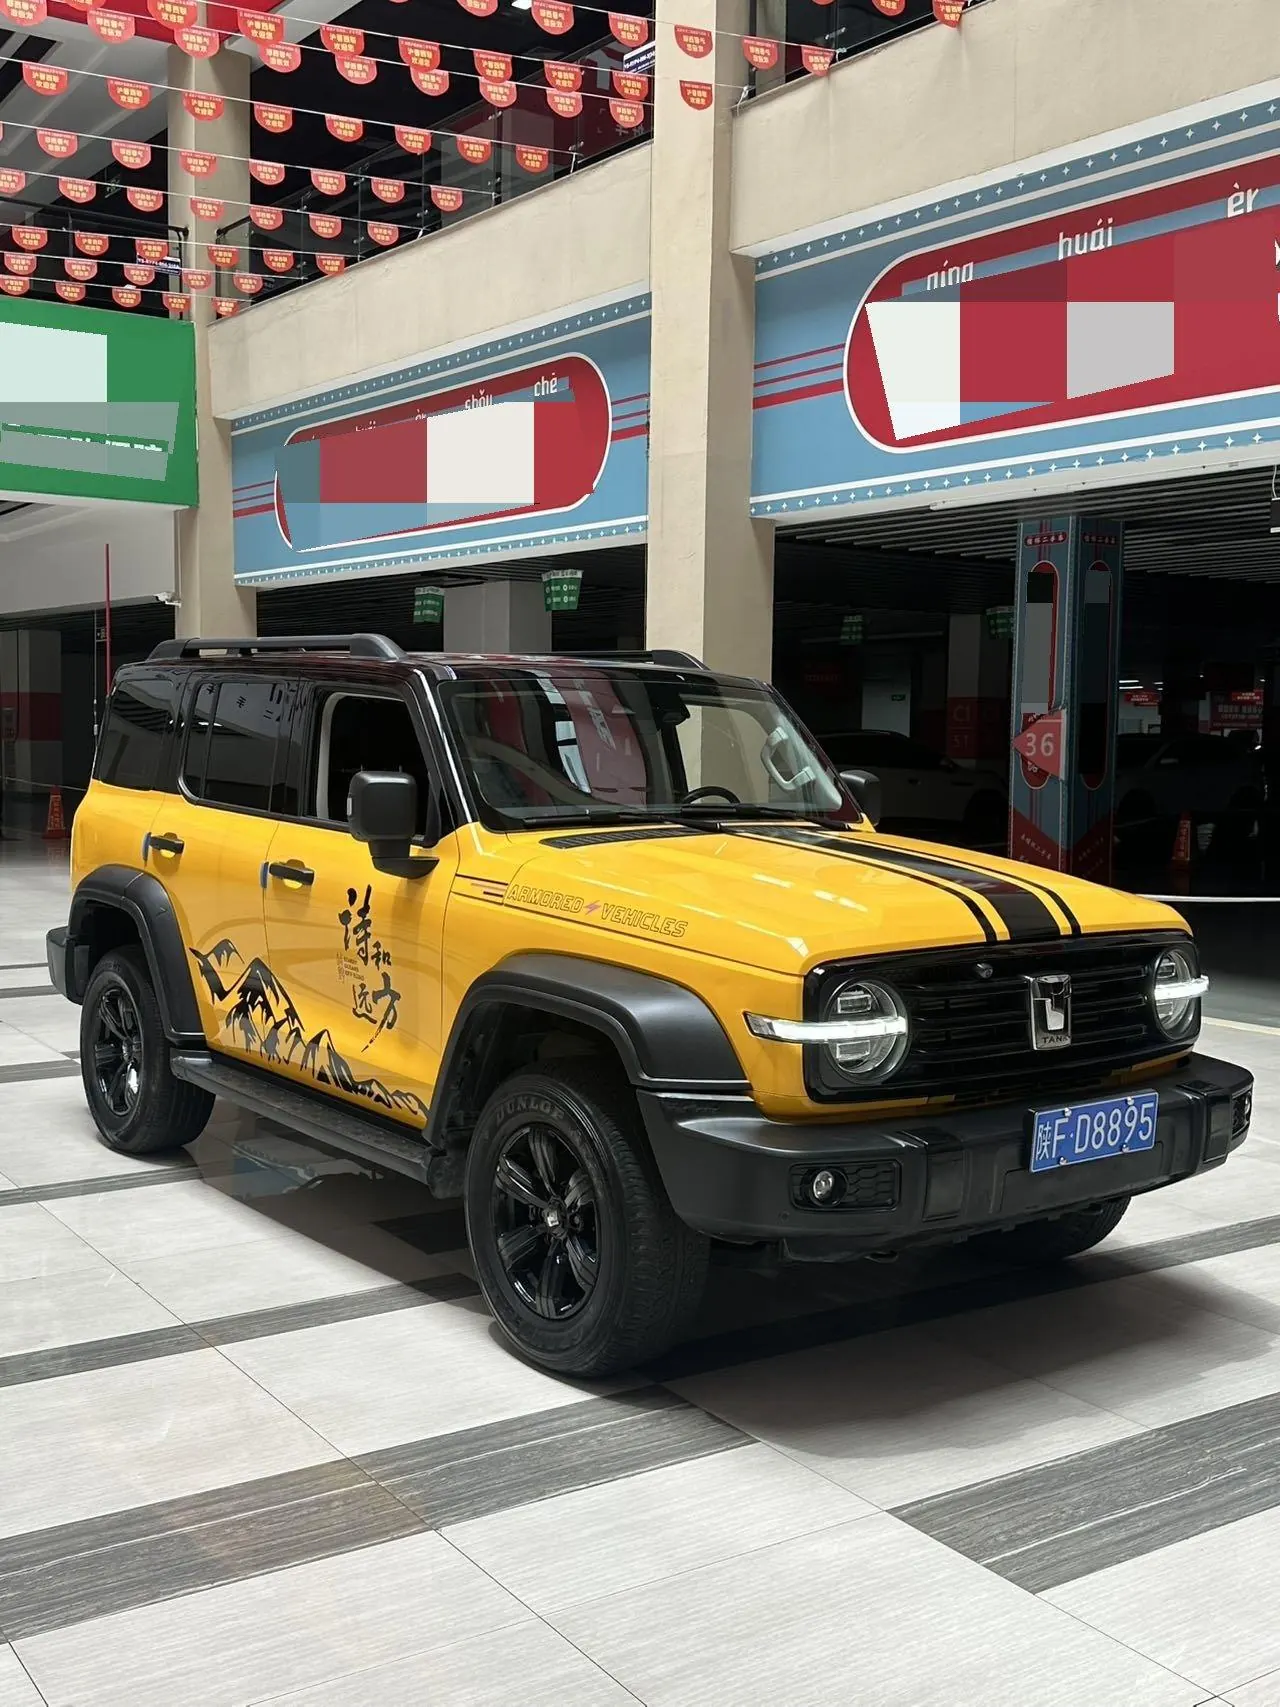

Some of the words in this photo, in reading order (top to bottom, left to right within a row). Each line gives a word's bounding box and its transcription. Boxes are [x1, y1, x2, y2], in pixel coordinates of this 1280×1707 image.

[1057, 217, 1114, 261] huái
[1226, 181, 1259, 218] èr
[1024, 733, 1054, 757] 36
[506, 884, 585, 914] ARMORED
[600, 902, 689, 938] VEHICLES
